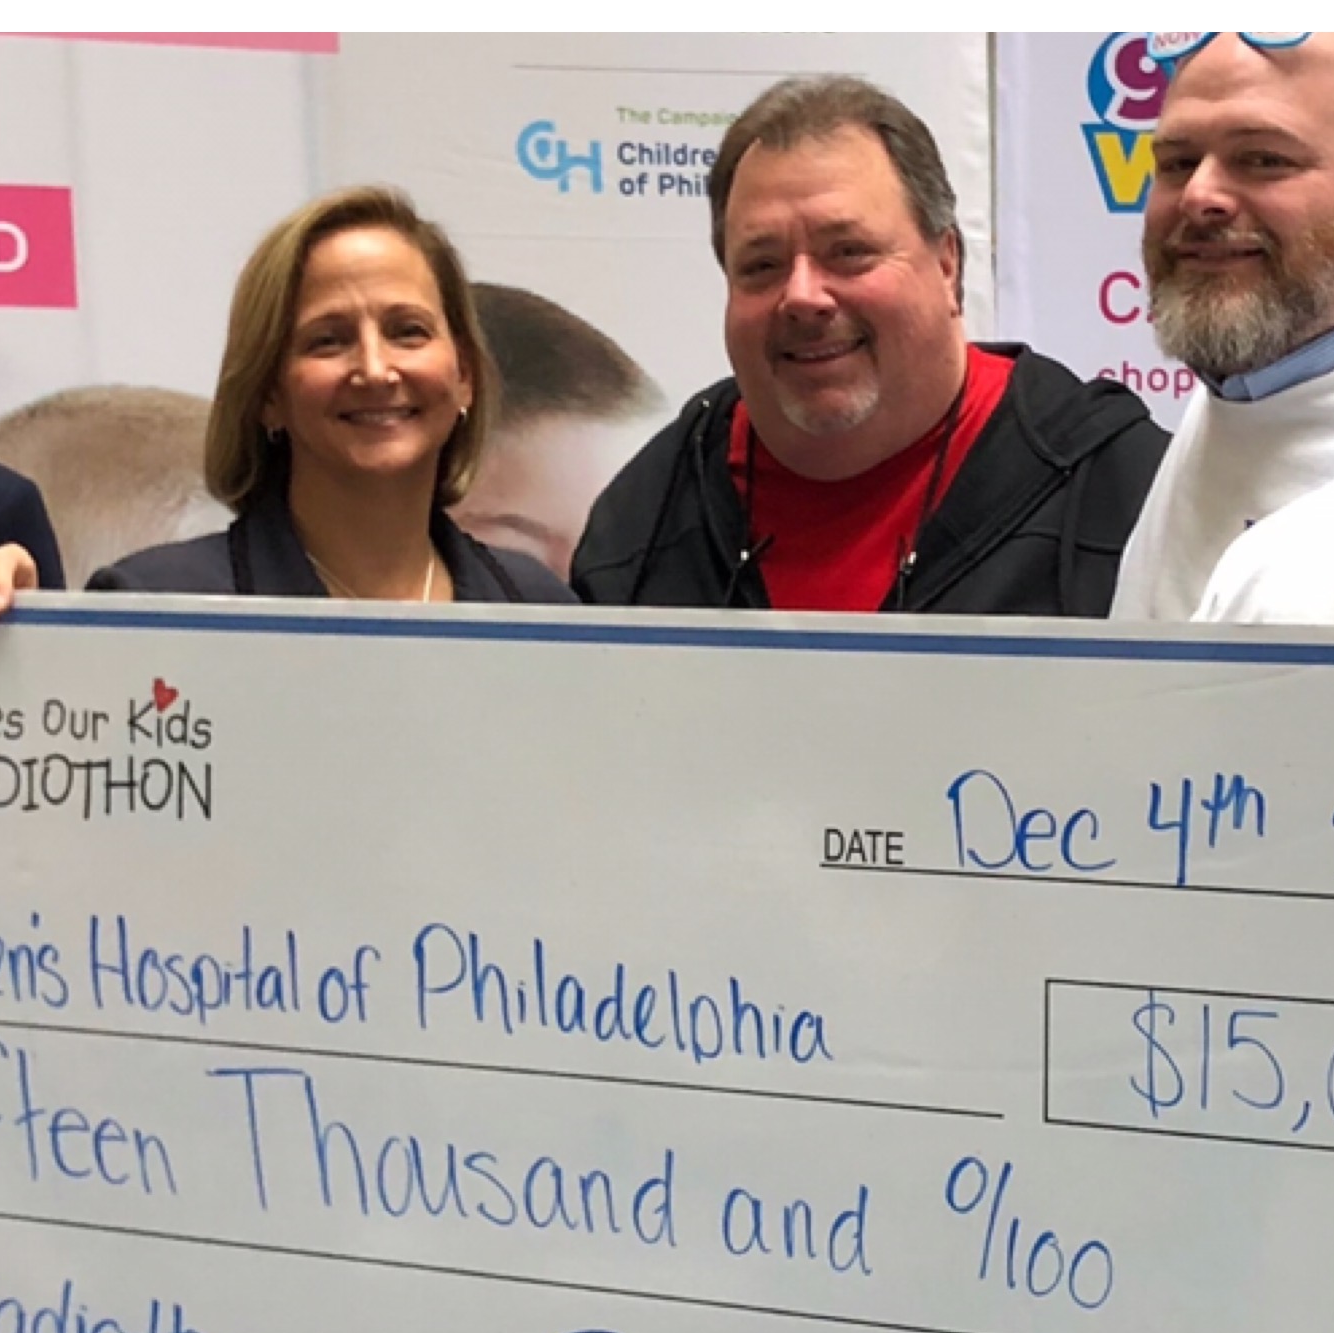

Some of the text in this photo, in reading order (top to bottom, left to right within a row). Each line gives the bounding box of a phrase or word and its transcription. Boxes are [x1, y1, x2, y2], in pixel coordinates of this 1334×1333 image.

[616, 107, 736, 127] The Campai
[617, 141, 716, 167] Childre
[619, 173, 648, 196] of
[43, 699, 109, 744] Our
[128, 695, 214, 750] Kids
[822, 828, 905, 867] DATE
[946, 768, 1116, 873] Dec
[1147, 772, 1265, 888] 4th
[88, 914, 300, 1025] Hospital
[317, 947, 381, 1024] of
[412, 923, 834, 1065] Philadelphia
[206, 1066, 678, 1248] Thousand
[720, 1184, 873, 1276] and
